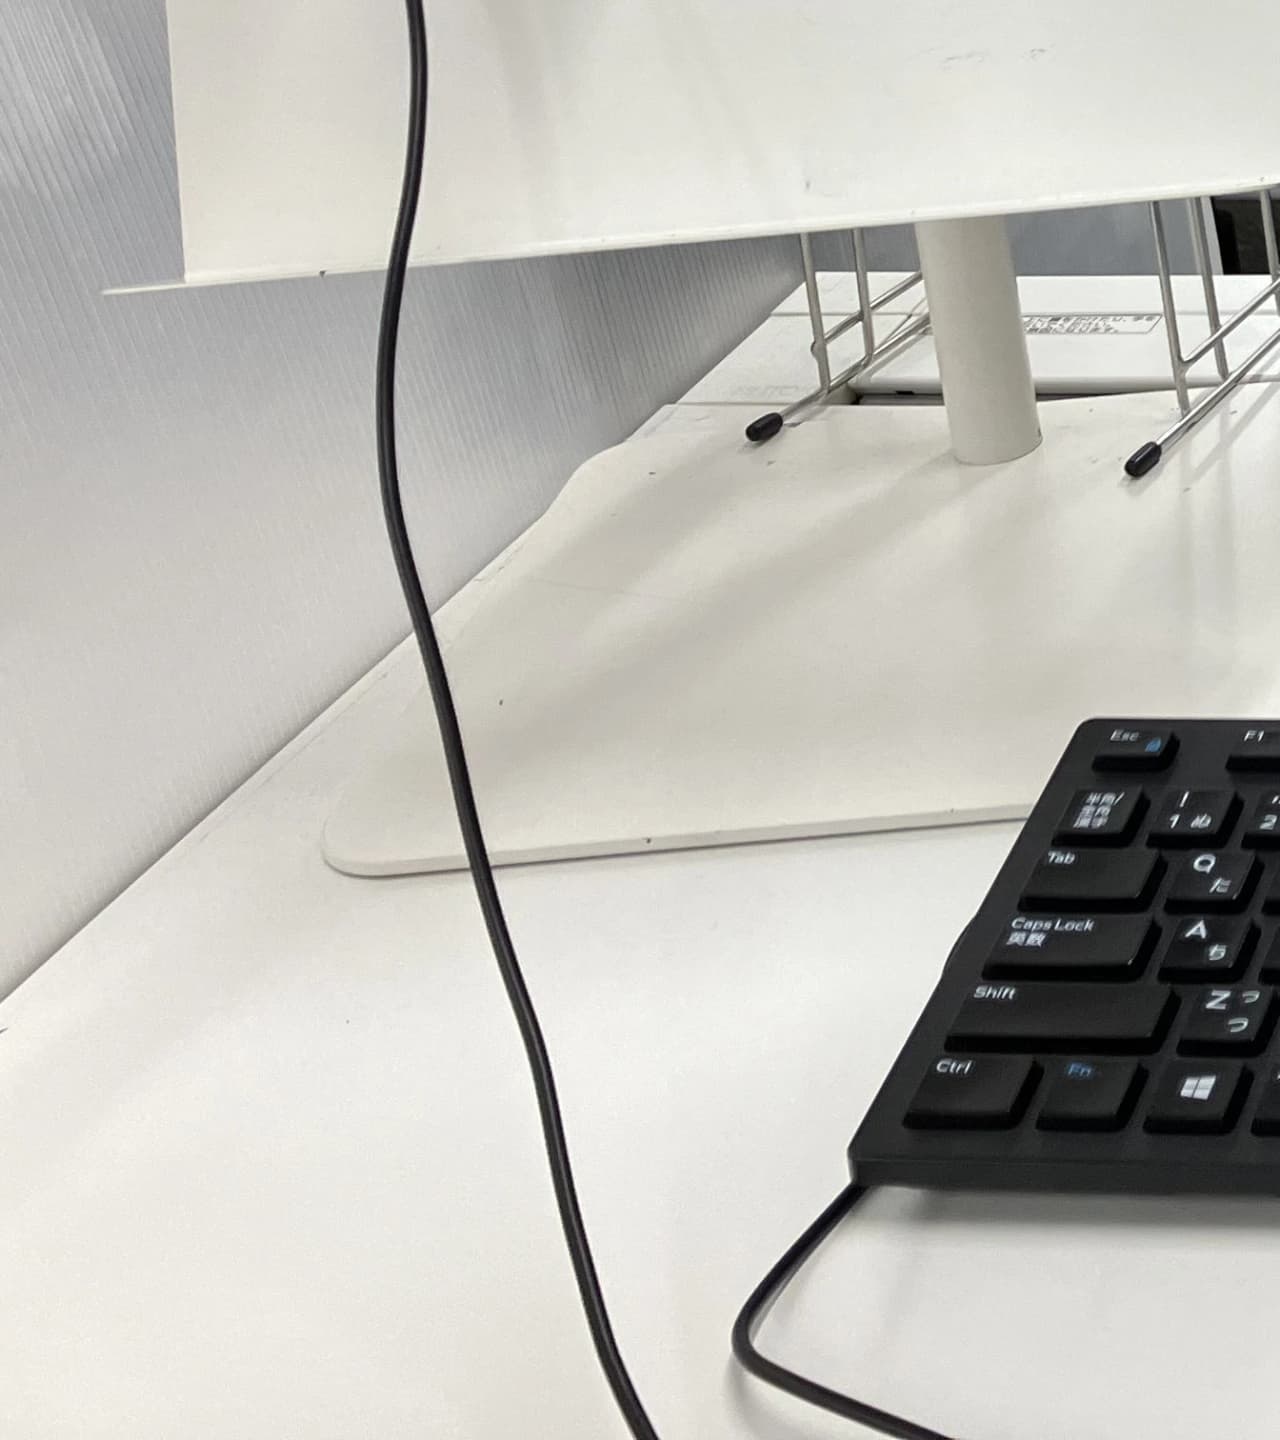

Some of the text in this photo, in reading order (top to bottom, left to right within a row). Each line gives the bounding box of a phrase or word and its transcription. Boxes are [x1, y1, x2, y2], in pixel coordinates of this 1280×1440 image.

[1110, 729, 1140, 742] Esc
[1244, 730, 1265, 742] F1
[1047, 851, 1076, 865] Tab
[1192, 854, 1216, 874] Q
[1010, 916, 1094, 933] Caps Lock
[1184, 920, 1208, 939] A
[973, 985, 1016, 1001] Shift
[1205, 990, 1232, 1010] Z
[936, 1058, 973, 1074] Ctrl
[1066, 1063, 1094, 1078] Fn
